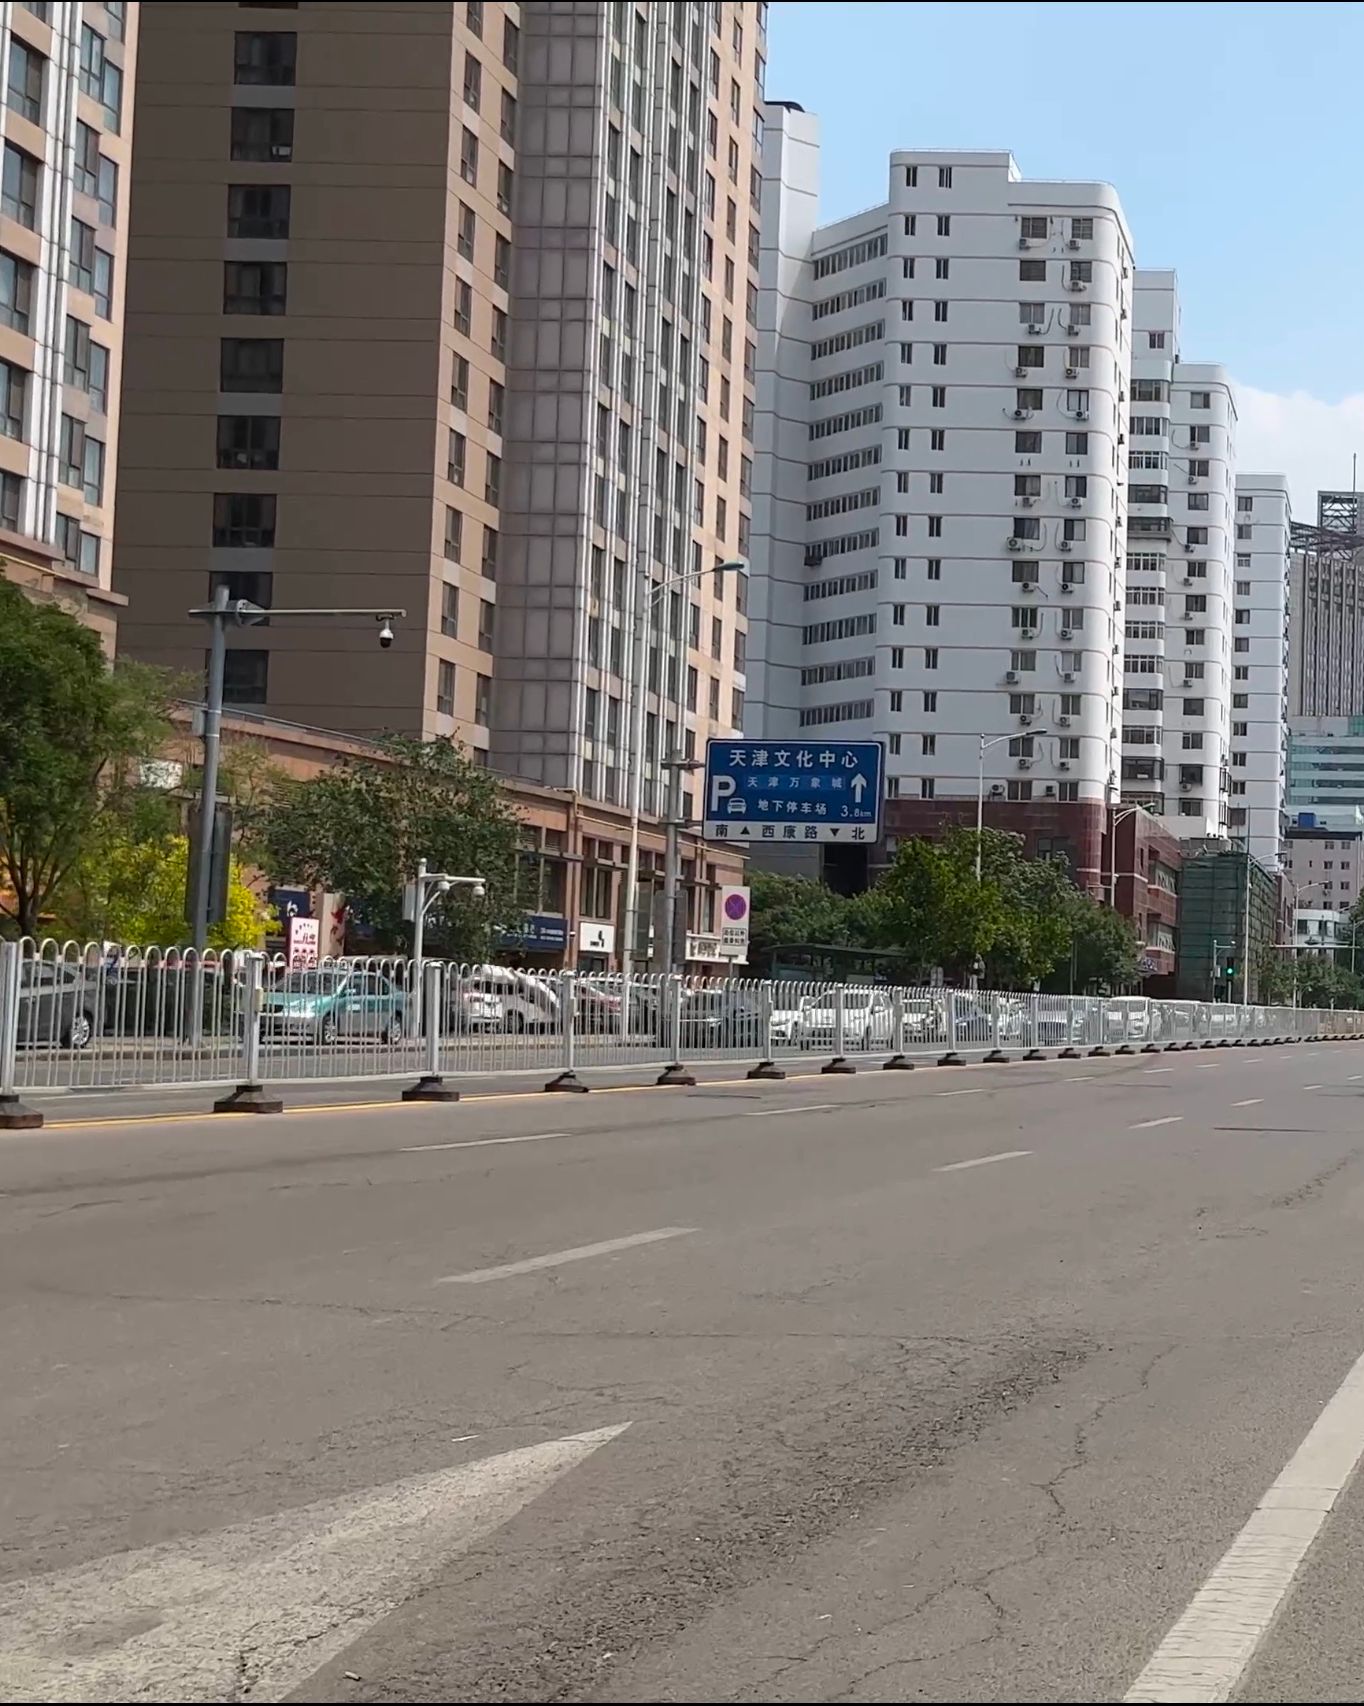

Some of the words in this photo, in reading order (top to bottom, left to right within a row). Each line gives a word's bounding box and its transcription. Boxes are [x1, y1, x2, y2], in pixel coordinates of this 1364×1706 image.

[729, 749, 859, 768] 天津文化中心
[757, 799, 828, 816] 地下停车场
[840, 805, 872, 818] 3.8km
[715, 824, 729, 838] 南
[762, 825, 818, 840] 西康路
[852, 827, 866, 841] 北
